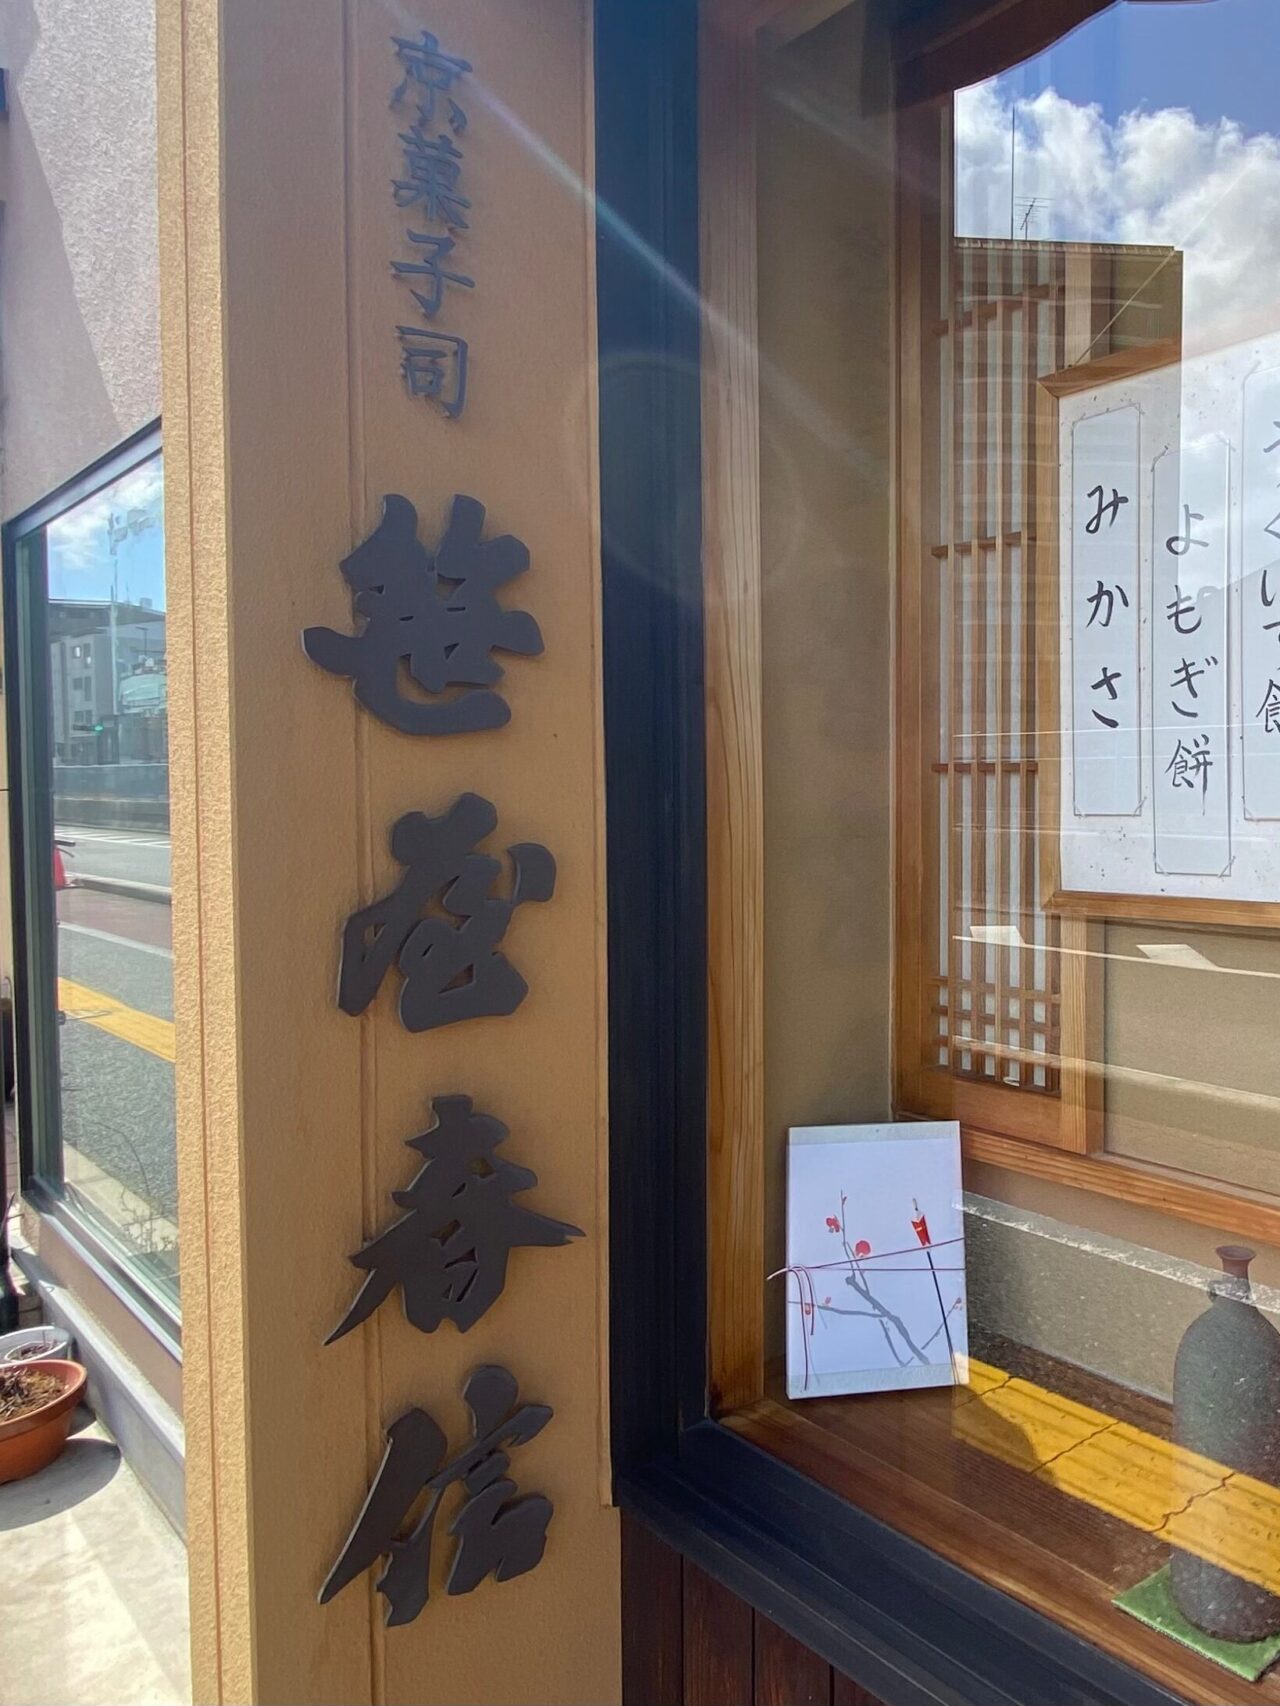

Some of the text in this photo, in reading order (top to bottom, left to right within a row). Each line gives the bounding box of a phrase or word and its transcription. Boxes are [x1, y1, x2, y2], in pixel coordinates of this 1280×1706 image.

[389, 28, 475, 420] 京菓子司
[1085, 485, 1129, 729] みかさ
[1165, 503, 1219, 812] よもぎ餅
